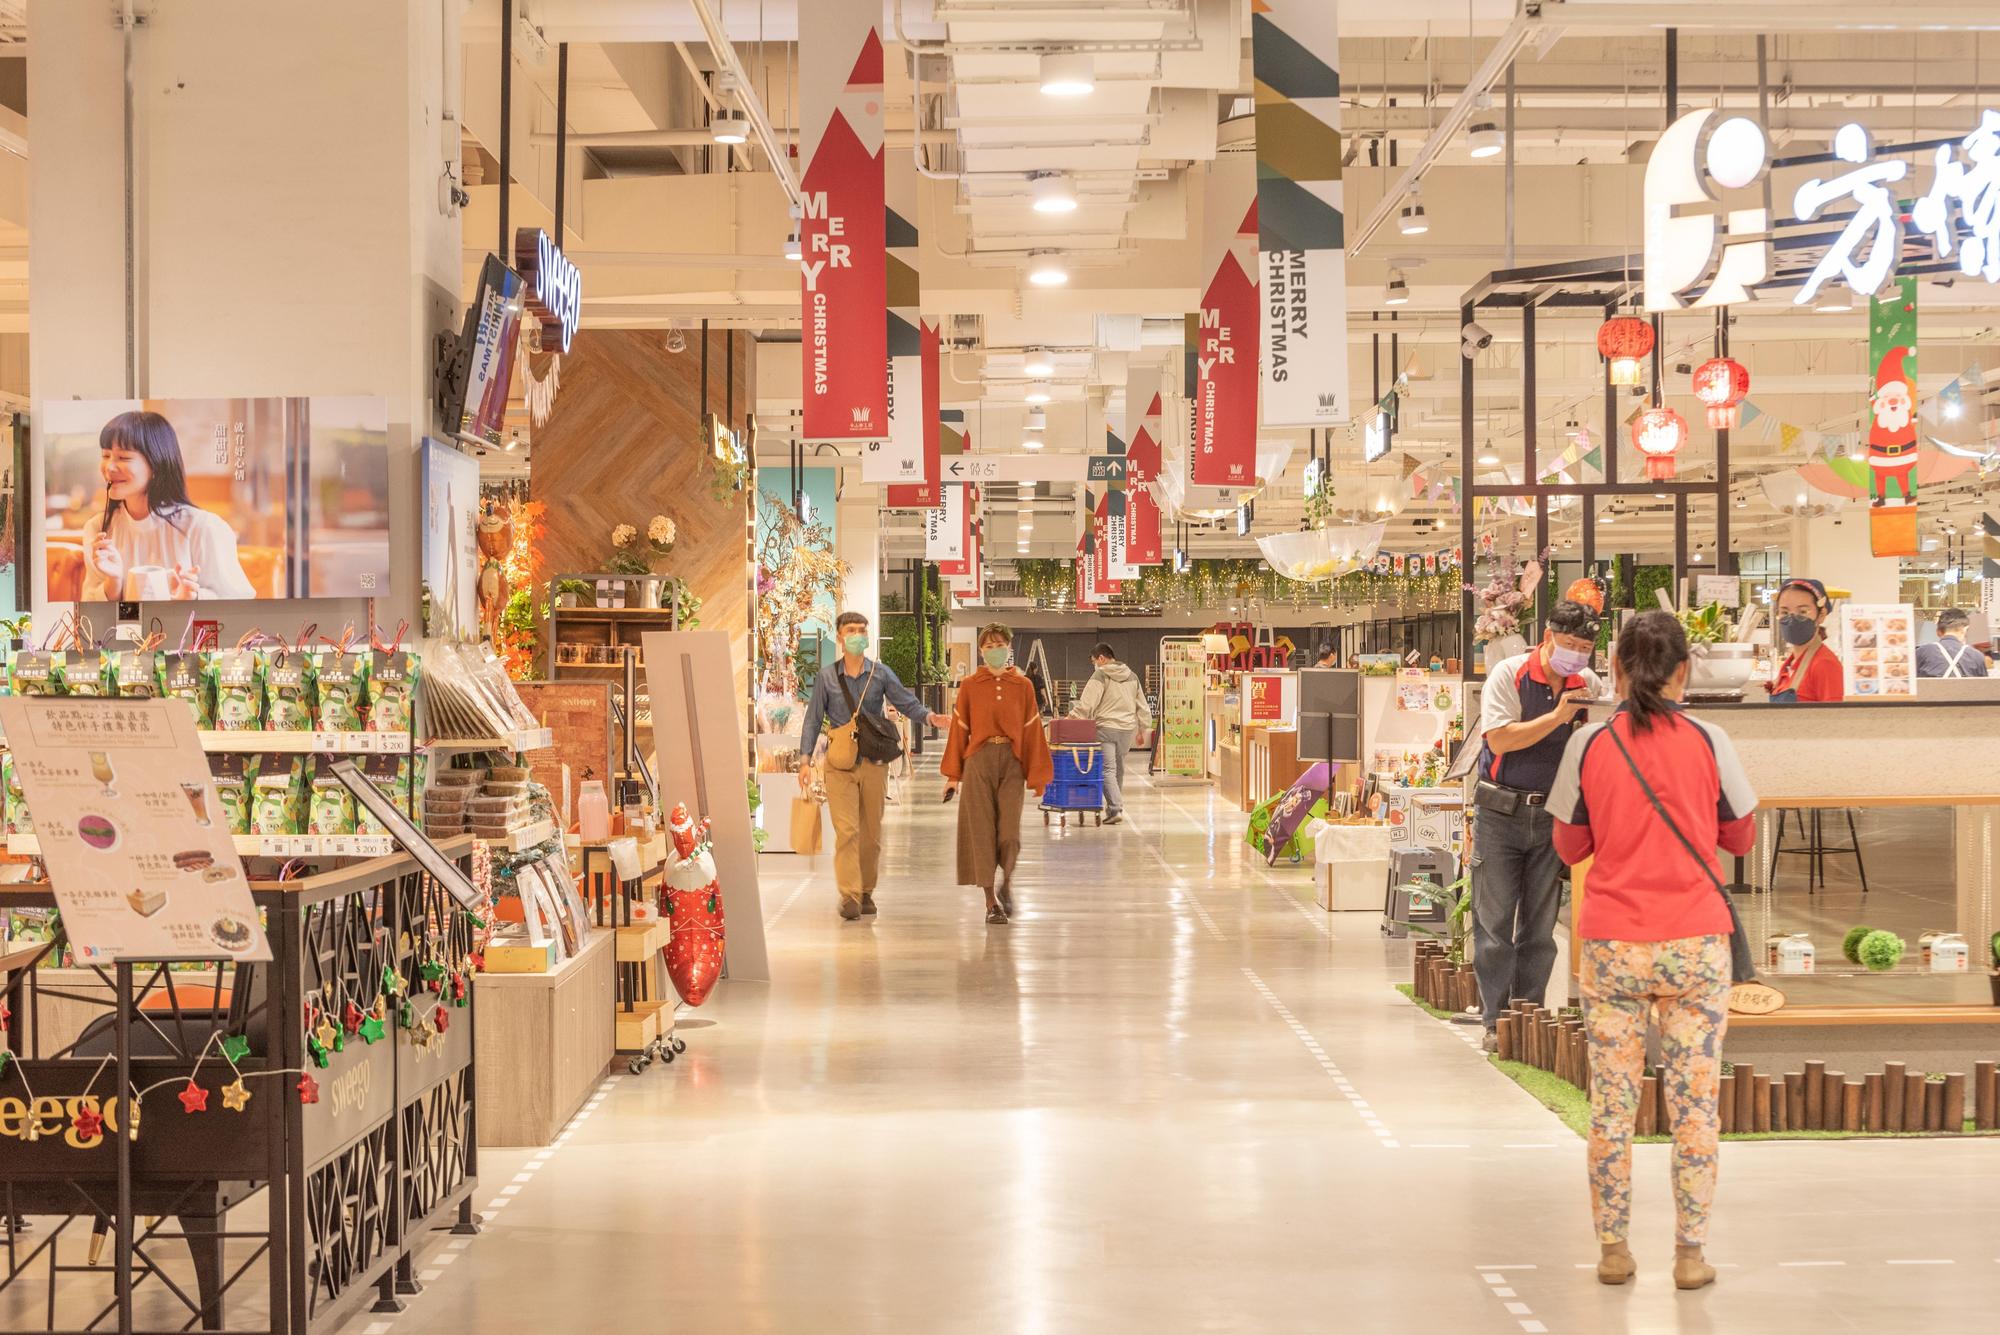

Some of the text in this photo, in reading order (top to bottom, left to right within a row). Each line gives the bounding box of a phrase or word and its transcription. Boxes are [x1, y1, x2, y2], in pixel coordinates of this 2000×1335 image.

[800, 191, 852, 291] MERRY
[537, 229, 581, 353] sweego
[1269, 250, 1288, 383] CHRISTMAS
[1290, 250, 1308, 339] MERRY
[813, 293, 828, 395] CHRISTMAS
[1198, 308, 1235, 380] MERRY
[1203, 381, 1216, 455] CHRISTMAS
[930, 509, 938, 541] STMAS
[562, 698, 597, 707] SNOOPY
[1251, 681, 1267, 699] 賀
[390, 742, 404, 750] 200
[362, 845, 377, 853] 200
[332, 1058, 370, 1117] sweego
